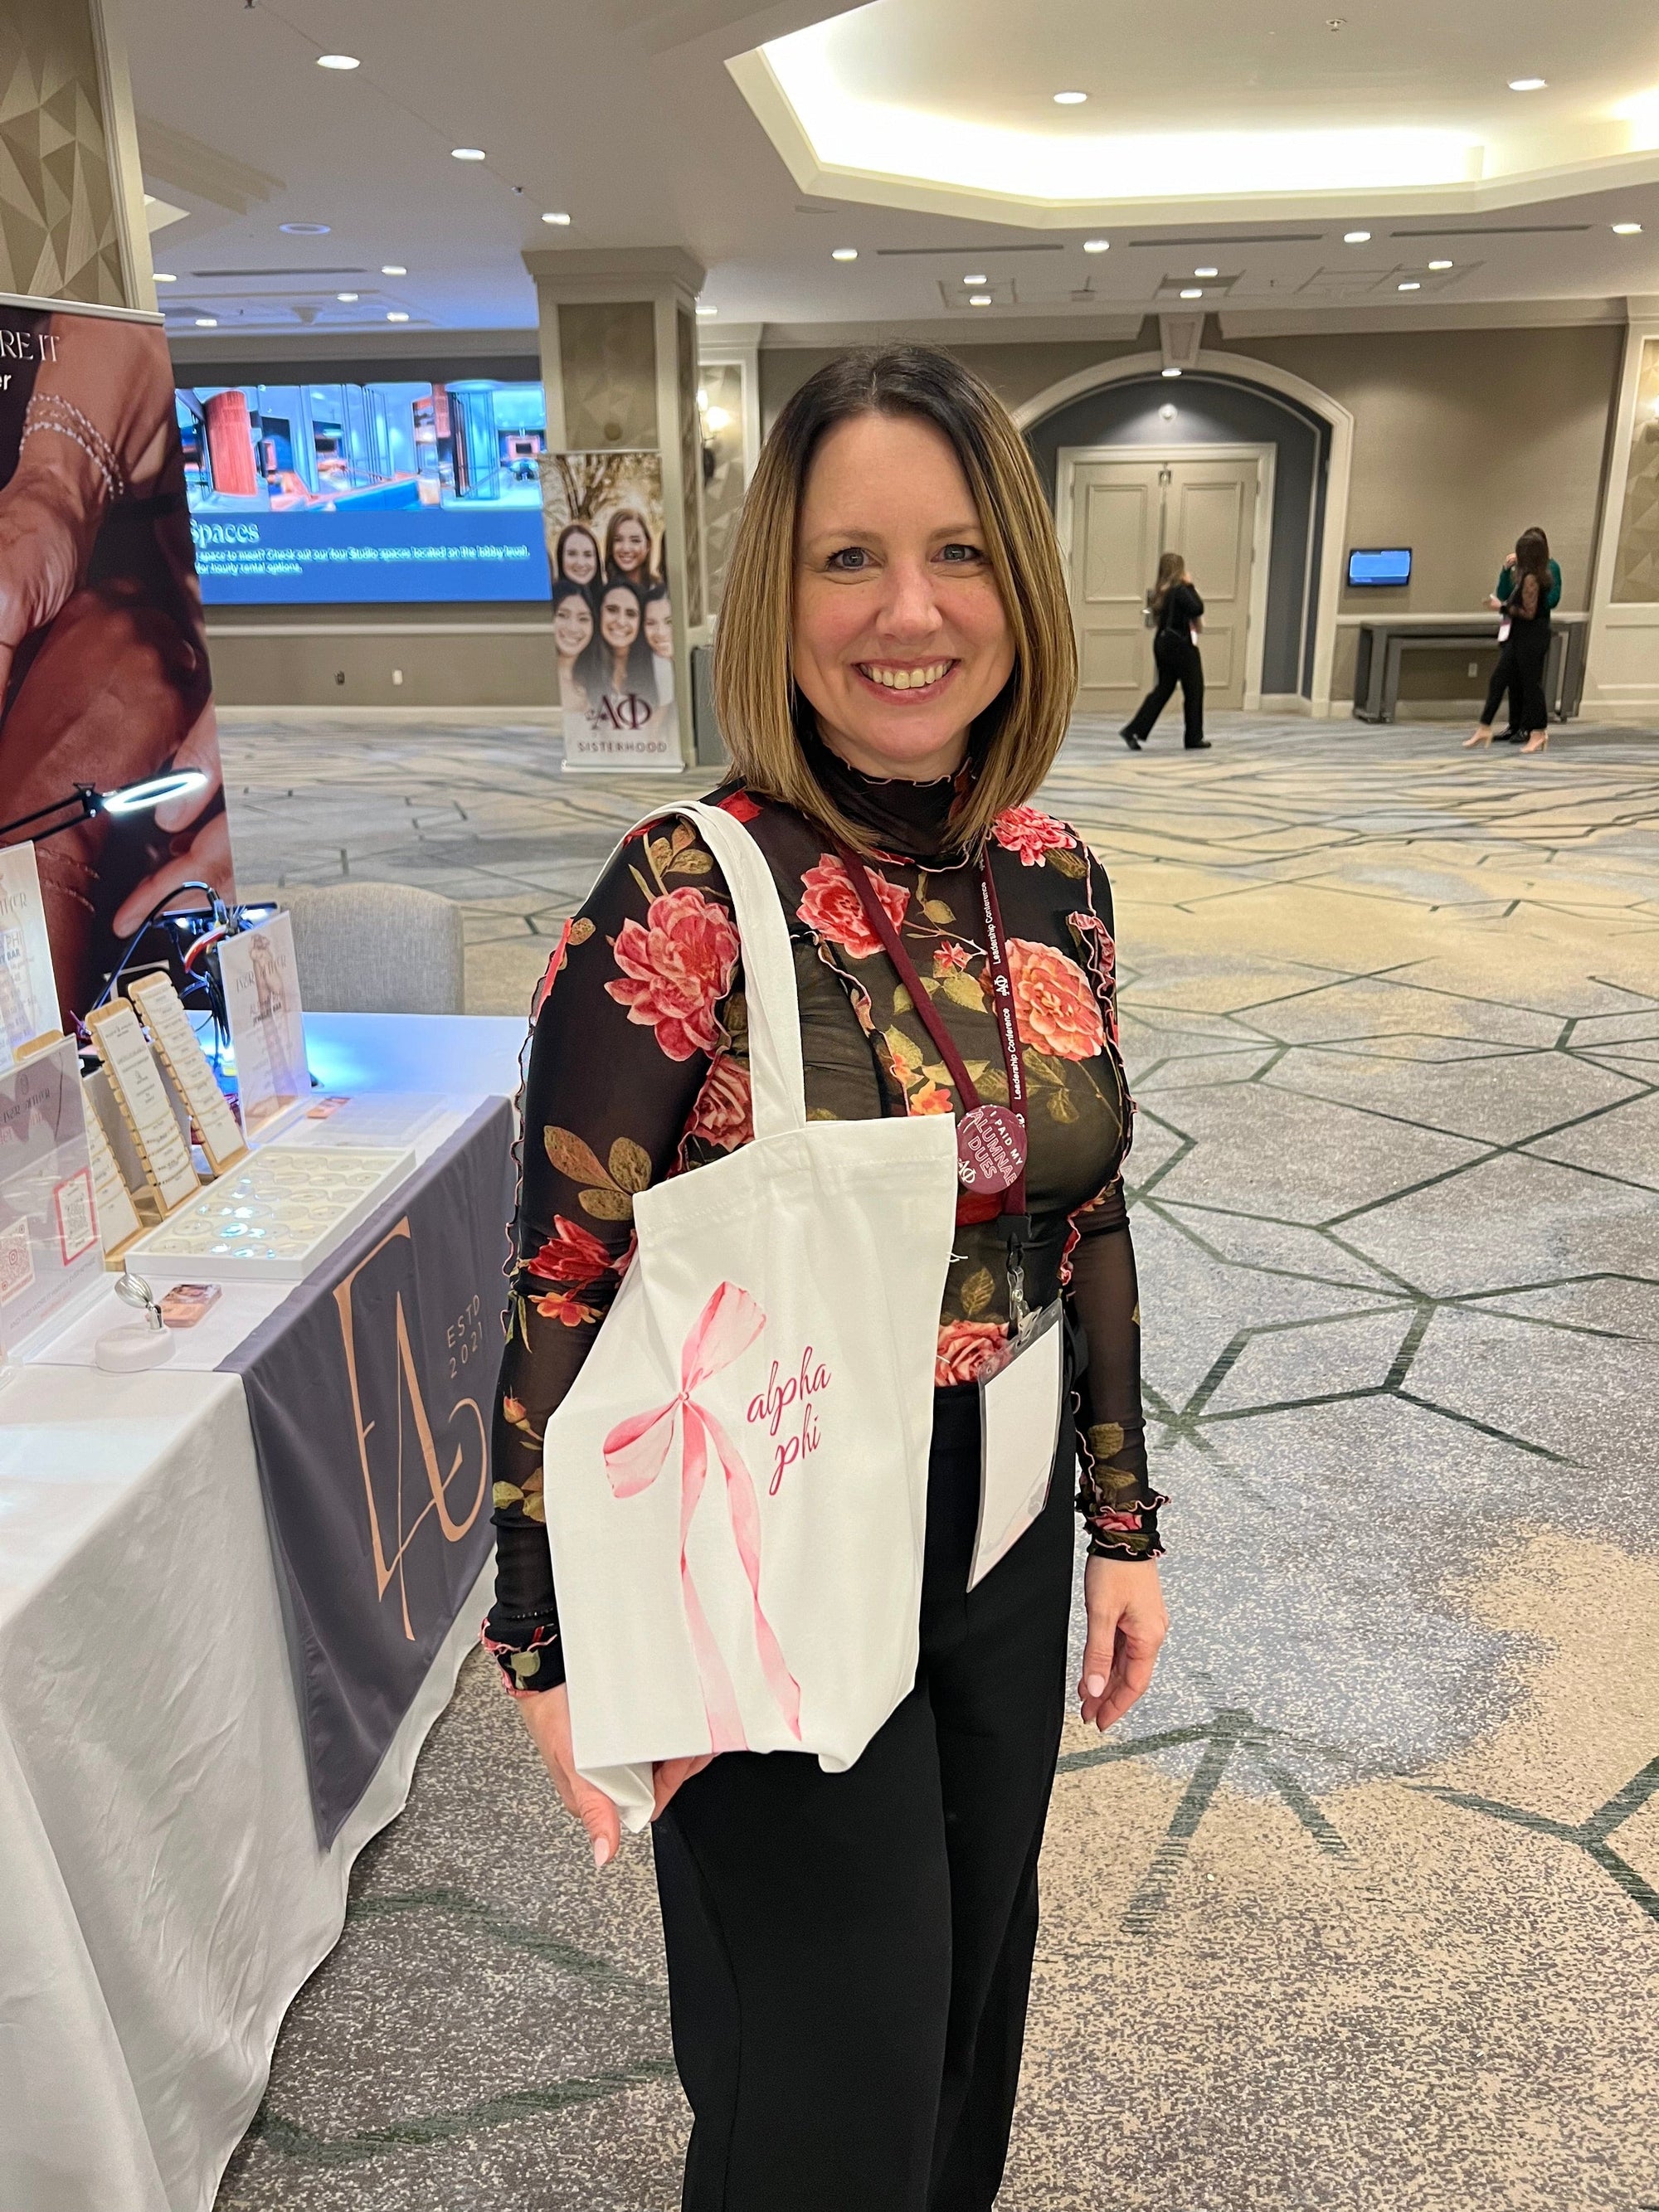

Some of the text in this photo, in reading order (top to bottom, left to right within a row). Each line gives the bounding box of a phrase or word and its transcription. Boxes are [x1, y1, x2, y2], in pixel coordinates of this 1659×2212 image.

[39, 334, 61, 362] IT
[211, 562, 238, 576] hourly
[241, 562, 265, 573] rental
[227, 550, 237, 562] to
[266, 548, 295, 562] Check
[297, 548, 312, 561] out
[348, 546, 378, 560] Studio
[379, 547, 411, 562] spaces
[411, 545, 446, 560] located
[460, 545, 476, 558] the
[476, 545, 503, 562] lobby
[577, 741, 668, 753] SISTERHOOD
[980, 881, 994, 924] Conference
[987, 924, 1001, 965] Leadership
[1002, 1008, 1016, 1053] Conference
[1010, 1053, 1022, 1100] Leadership
[968, 1110, 1018, 1187] ALUMNAE
[968, 1135, 997, 1179] DUES
[994, 1119, 1013, 1146] PAID
[1010, 1148, 1024, 1165] MY
[446, 1294, 480, 1349] ESTD
[449, 1320, 483, 1379] 2021
[747, 1345, 831, 1437] alpha
[769, 1403, 821, 1496] phi
